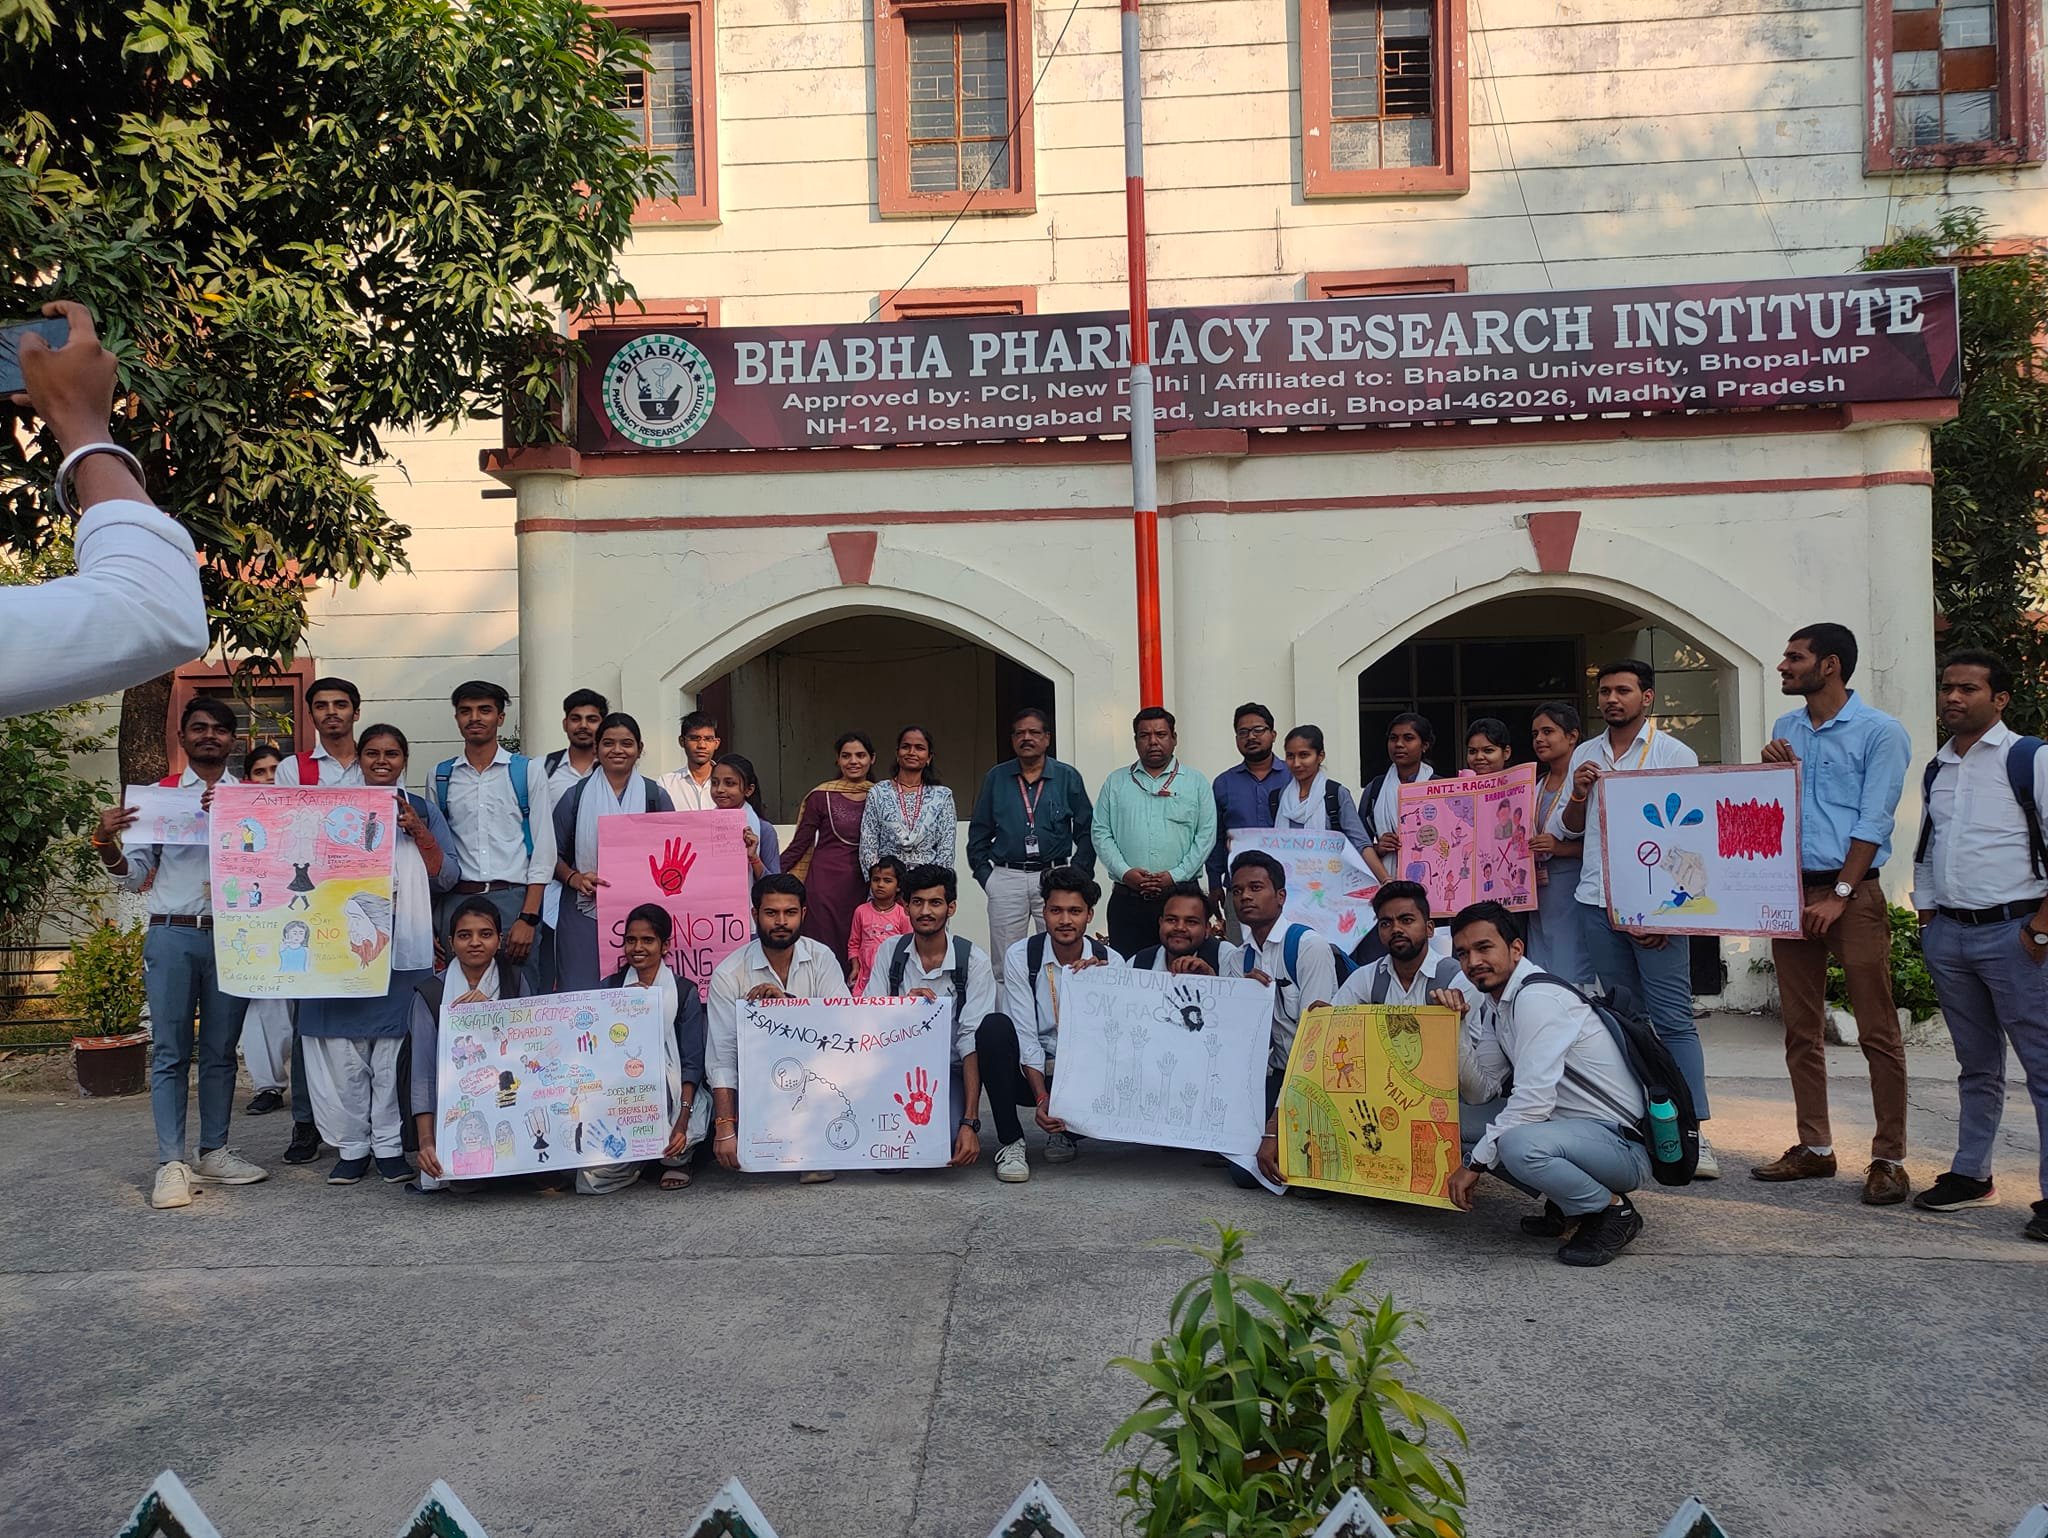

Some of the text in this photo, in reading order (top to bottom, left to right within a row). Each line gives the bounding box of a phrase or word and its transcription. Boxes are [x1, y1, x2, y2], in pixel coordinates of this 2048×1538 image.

[734, 286, 1925, 385] BHABHA PHARMACY RESEARCH INSTITUTE
[617, 344, 698, 375] BHABHA
[782, 346, 1870, 412] Approved by: PCI, New Dlhi Affiliated to: Bhabha University, Bhopal-MP
[612, 388, 640, 430] PHARMACY
[685, 384, 705, 426] INSTITUTE
[806, 375, 1845, 435] NH-12, Hoshangabad Rad, Jatkhedi, Bhopal-462026, Madhya Pradesh
[638, 423, 686, 438] RESEARCH
[251, 791, 291, 806] ANTI
[1293, 839, 1315, 849] NO
[249, 920, 279, 929] CRIME
[671, 912, 745, 949] NO TO
[1758, 919, 1798, 931] VISHAL
[316, 927, 341, 940] NO
[249, 985, 281, 993] CRIME
[760, 996, 918, 1008] BHABHA UNIVERSITY
[1082, 991, 1118, 1017] SAY
[449, 1011, 505, 1031] RAGGING
[509, 1009, 523, 1024] IS
[525, 1007, 533, 1024] A
[534, 1006, 573, 1023] CRIME
[543, 1026, 553, 1037] IS
[754, 1014, 923, 1052] SAY NO 2 RAGGING
[523, 1041, 546, 1052] JAIL
[1384, 1080, 1416, 1111] PAIN
[607, 1107, 616, 1117] IT
[646, 1112, 660, 1122] AND
[631, 1124, 655, 1136] FAMILY
[877, 1113, 902, 1132] IT'S
[904, 1130, 917, 1144] A
[869, 1144, 911, 1160] CRIME
